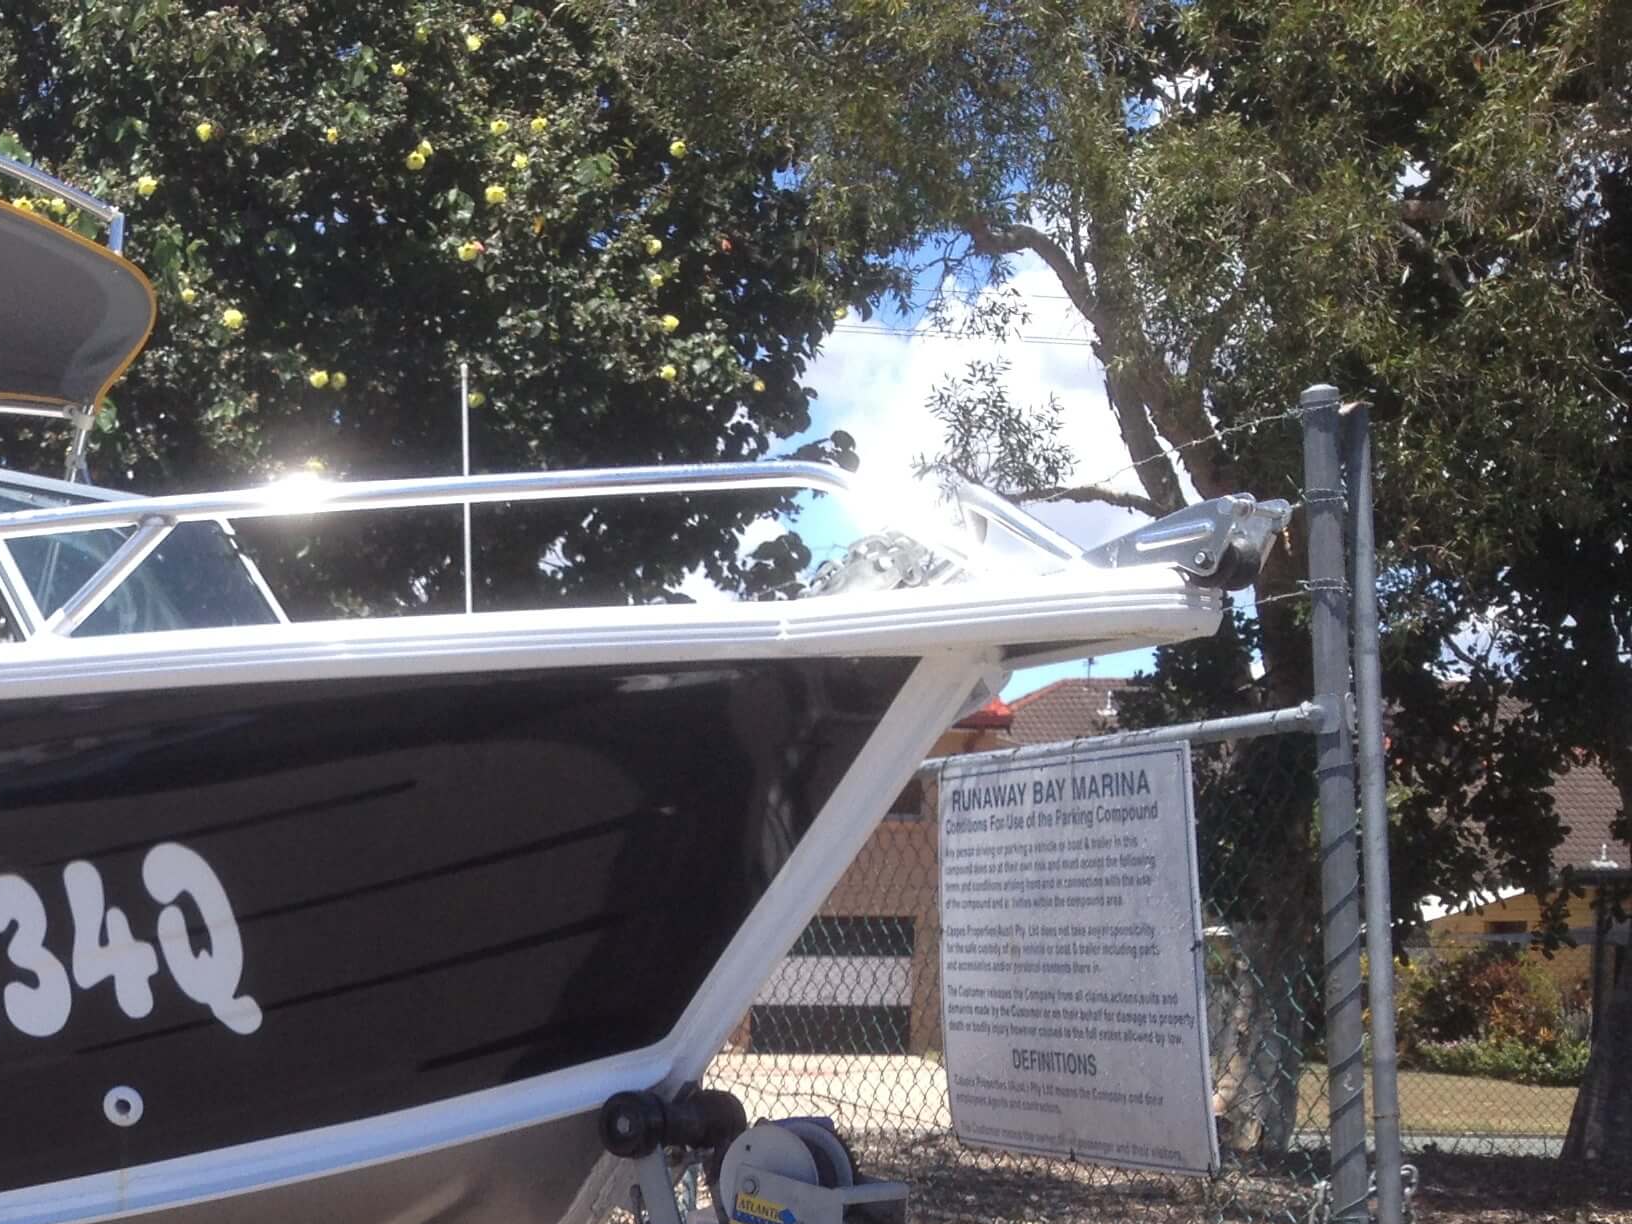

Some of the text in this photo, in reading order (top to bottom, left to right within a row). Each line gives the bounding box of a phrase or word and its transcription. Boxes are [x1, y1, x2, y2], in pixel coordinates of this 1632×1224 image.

[952, 769, 1151, 813] RUNAWAY BAY MARINA
[945, 801, 1159, 835] Conditions For Use of the Parking Compound
[1012, 1048, 1098, 1077] DEFINITIONS
